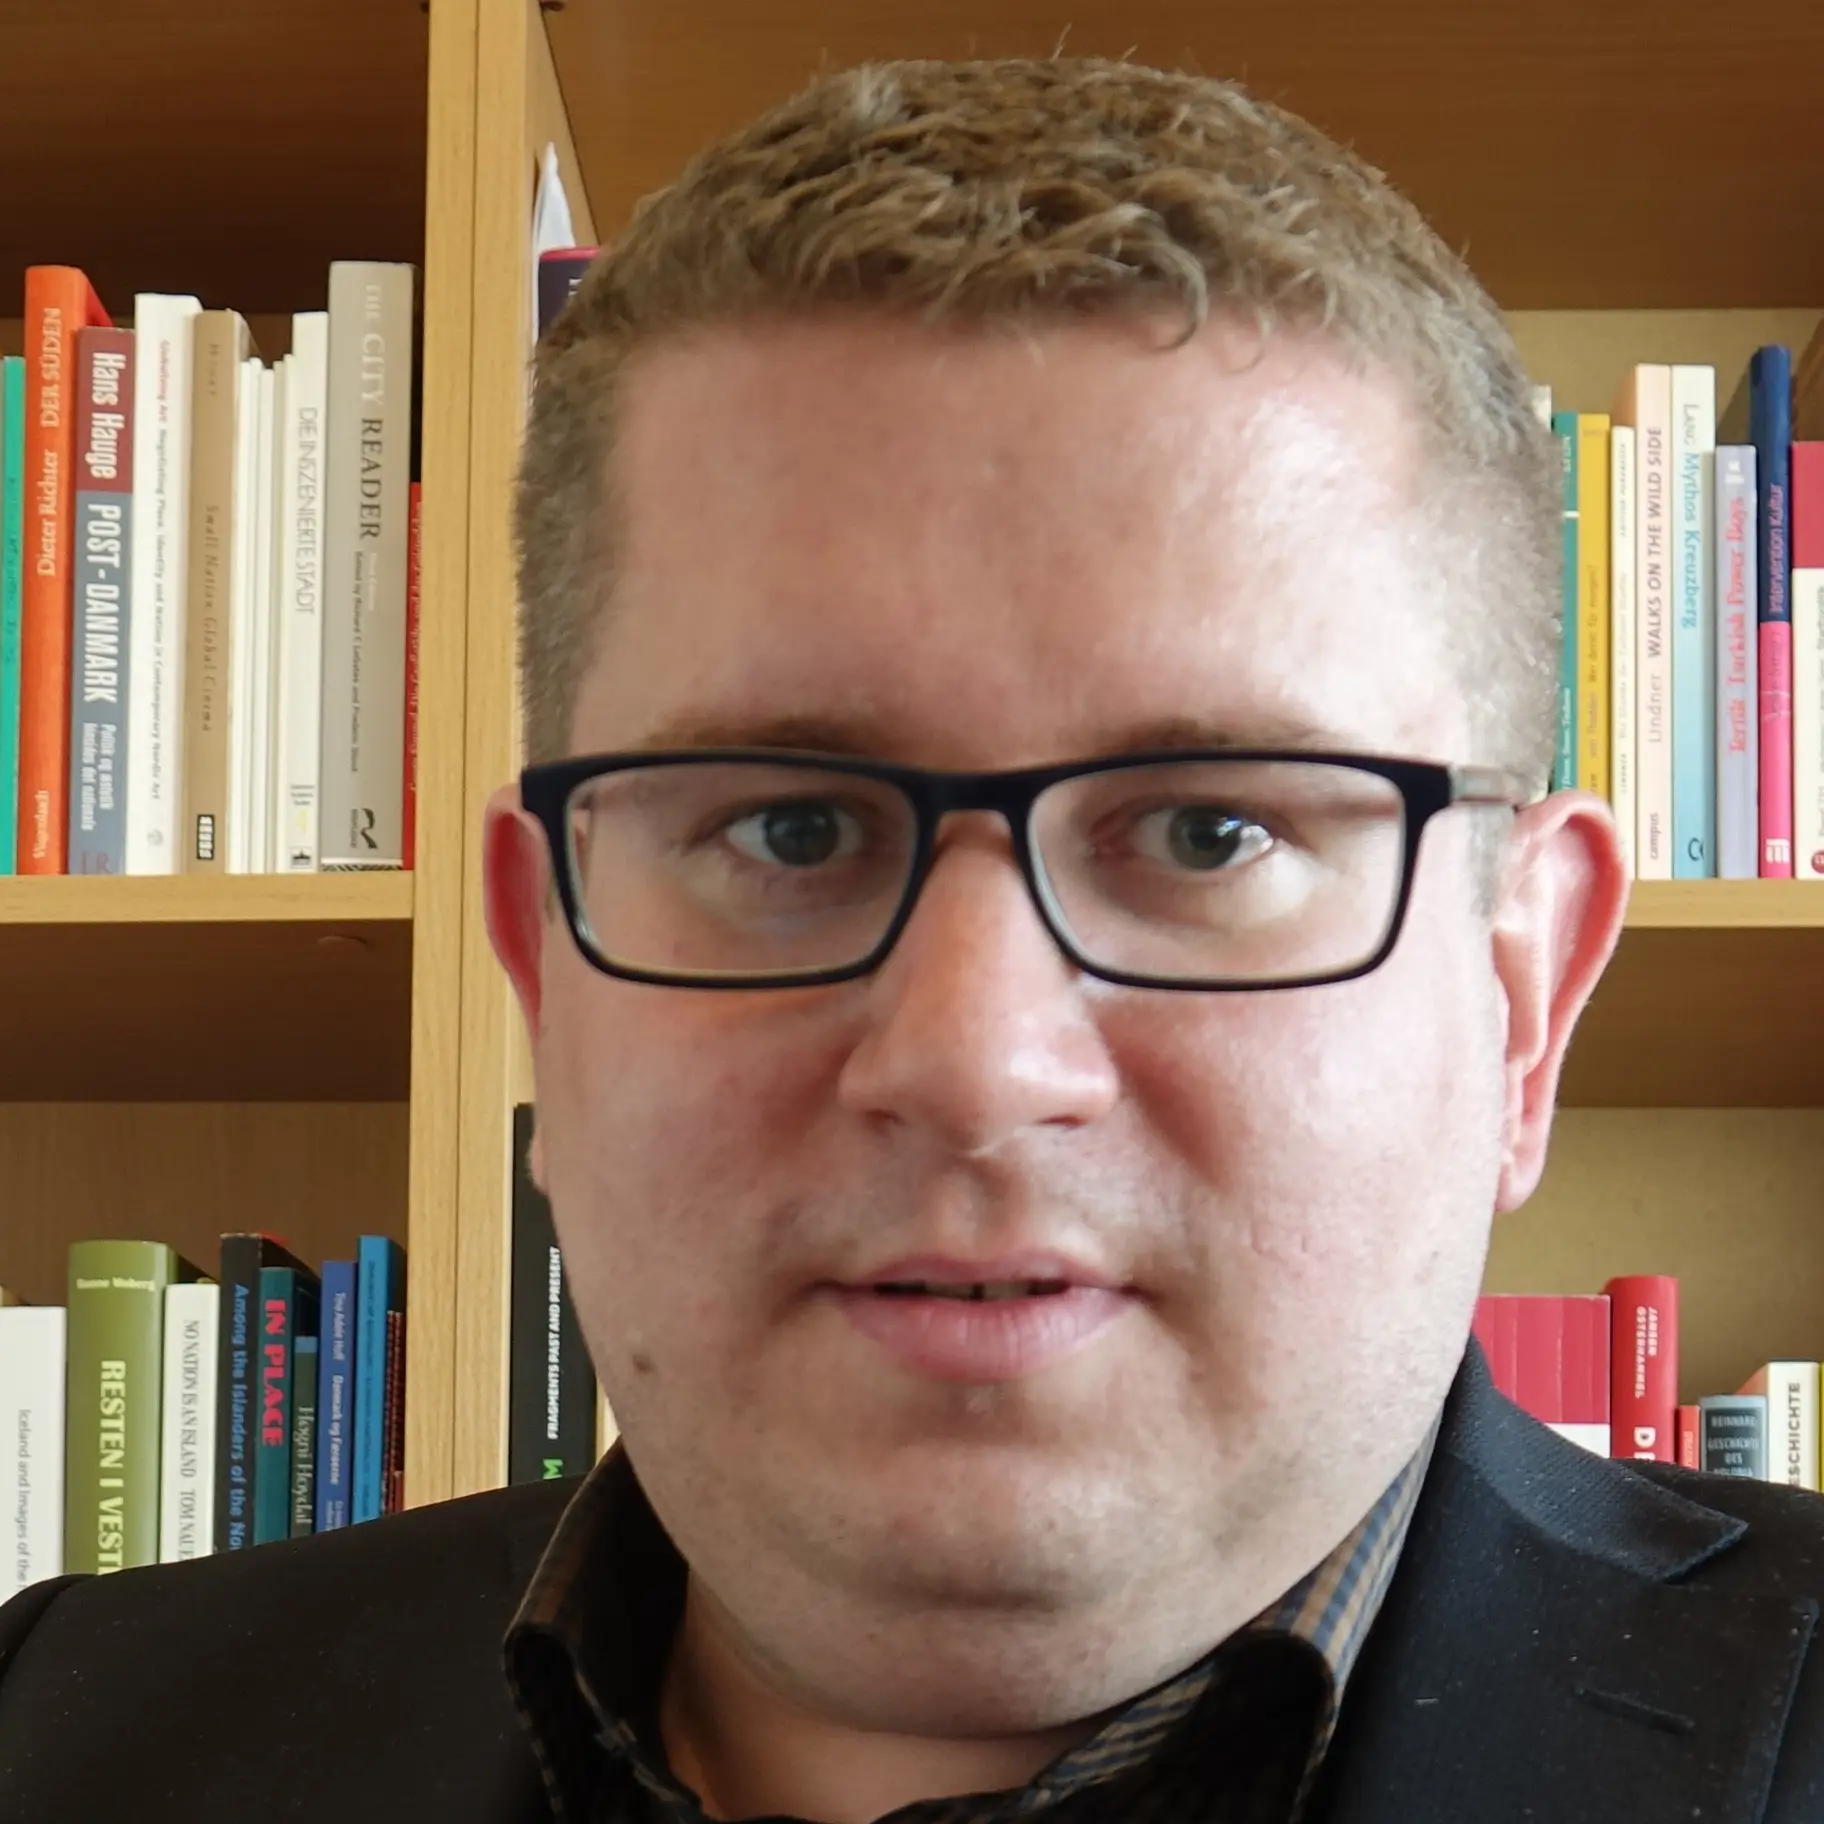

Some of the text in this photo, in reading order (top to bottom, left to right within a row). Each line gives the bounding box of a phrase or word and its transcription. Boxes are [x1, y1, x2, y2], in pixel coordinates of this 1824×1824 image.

[40, 308, 62, 427] DER SÜDEN
[361, 334, 385, 404] CITY
[85, 353, 125, 477] Hans Hauge
[1647, 428, 1662, 465] SIDE
[36, 449, 59, 576] Dieter Richter
[359, 419, 383, 540] READER
[1647, 472, 1662, 518] WILD
[1647, 524, 1662, 556] THE
[1648, 597, 1662, 658] WALKS
[231, 1285, 249, 1344] Among
[548, 1247, 561, 1439] FRAGMENTS PAST AND PRESENT
[231, 1351, 248, 1377] the
[263, 1345, 285, 1446] PLACE
[99, 1361, 125, 1468] RESTEN
[230, 1385, 247, 1459] Islanders
[230, 1489, 246, 1516] the
